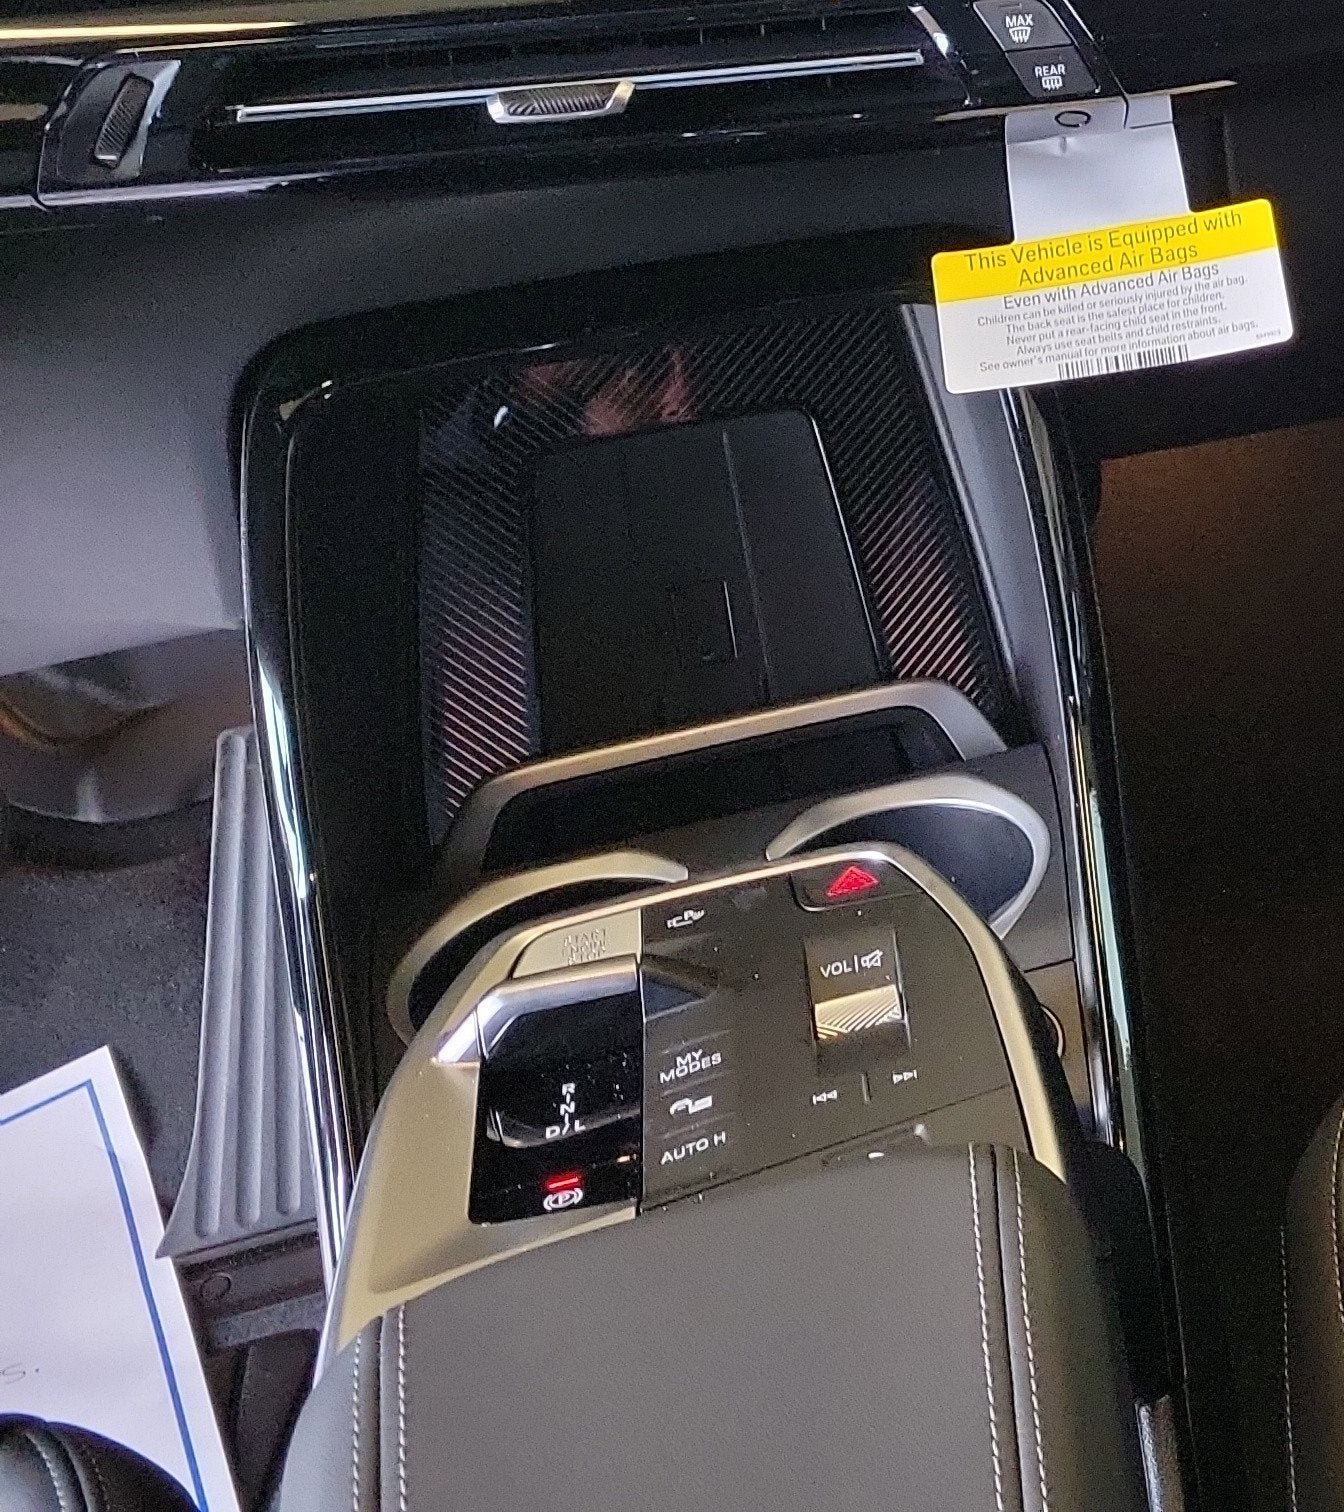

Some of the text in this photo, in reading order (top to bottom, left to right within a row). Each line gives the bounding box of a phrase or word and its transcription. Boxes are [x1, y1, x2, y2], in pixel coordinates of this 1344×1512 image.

[1005, 14, 1033, 27] MAX
[1034, 63, 1066, 77] REAR
[964, 212, 1242, 271] This Vehicle is Equipped with
[1019, 244, 1199, 287] Advanced Air Bags
[977, 274, 1248, 327] Children can be killed or seriously injured by the air bag.
[1003, 263, 1219, 310] Even with Advanced Air Bags
[1006, 322, 1026, 335] The
[1028, 318, 1051, 331] back
[1053, 315, 1076, 328] seat
[1088, 310, 1105, 322] the
[1107, 304, 1137, 319] safest
[1139, 299, 1165, 315] place
[1167, 296, 1180, 308] for
[1182, 290, 1225, 307] children.
[1006, 333, 1037, 346] Never
[1039, 330, 1055, 343] put
[1065, 319, 1121, 338] rear-facing
[1123, 313, 1148, 328] child
[1149, 311, 1170, 324] seat
[1182, 306, 1199, 318] the
[1200, 301, 1227, 316] front.
[980, 319, 1259, 373] See owner's manual for more information about air bags.
[1016, 314, 1222, 357] Always use seat belts and child restraints.
[819, 959, 853, 979] VOL
[659, 1052, 722, 1084] MODES
[675, 1050, 703, 1068] MY
[560, 1100, 576, 1116] N
[545, 1125, 560, 1140] D
[660, 1132, 727, 1166] AUTO H
